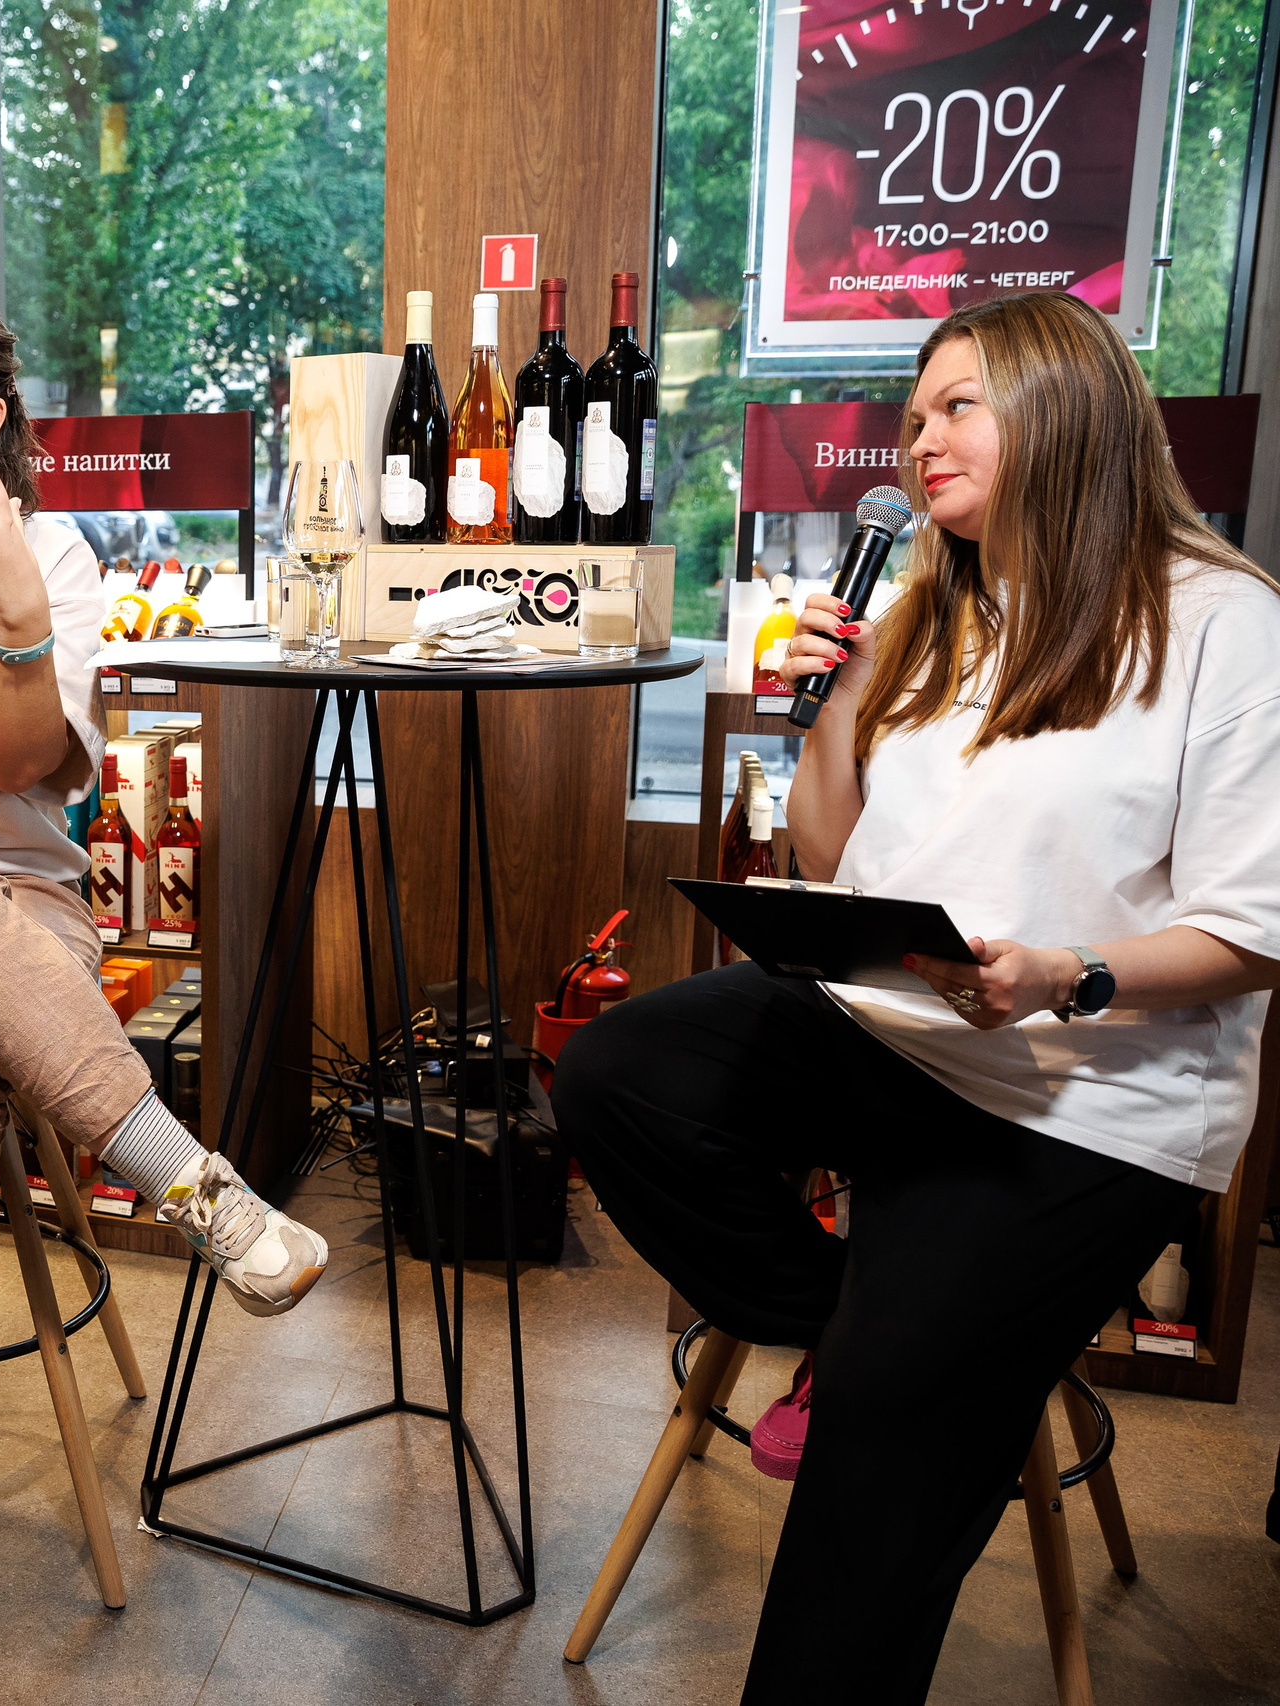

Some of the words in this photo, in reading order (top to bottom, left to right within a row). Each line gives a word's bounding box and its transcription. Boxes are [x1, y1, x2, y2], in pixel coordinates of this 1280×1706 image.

[856, 84, 1066, 205] -20%
[829, 272, 968, 292] ПОНЕДЕЛЬНИК
[990, 270, 1075, 288] ЧЕТВЕРГ
[27, 455, 56, 473] ие
[63, 452, 171, 472] напитки
[771, 682, 788, 691] -20
[93, 915, 110, 924] 25%
[162, 919, 183, 928] -25%
[33, 1177, 49, 1187] 1+1=
[104, 1186, 124, 1196] -20%
[1151, 1322, 1178, 1333] -20%
